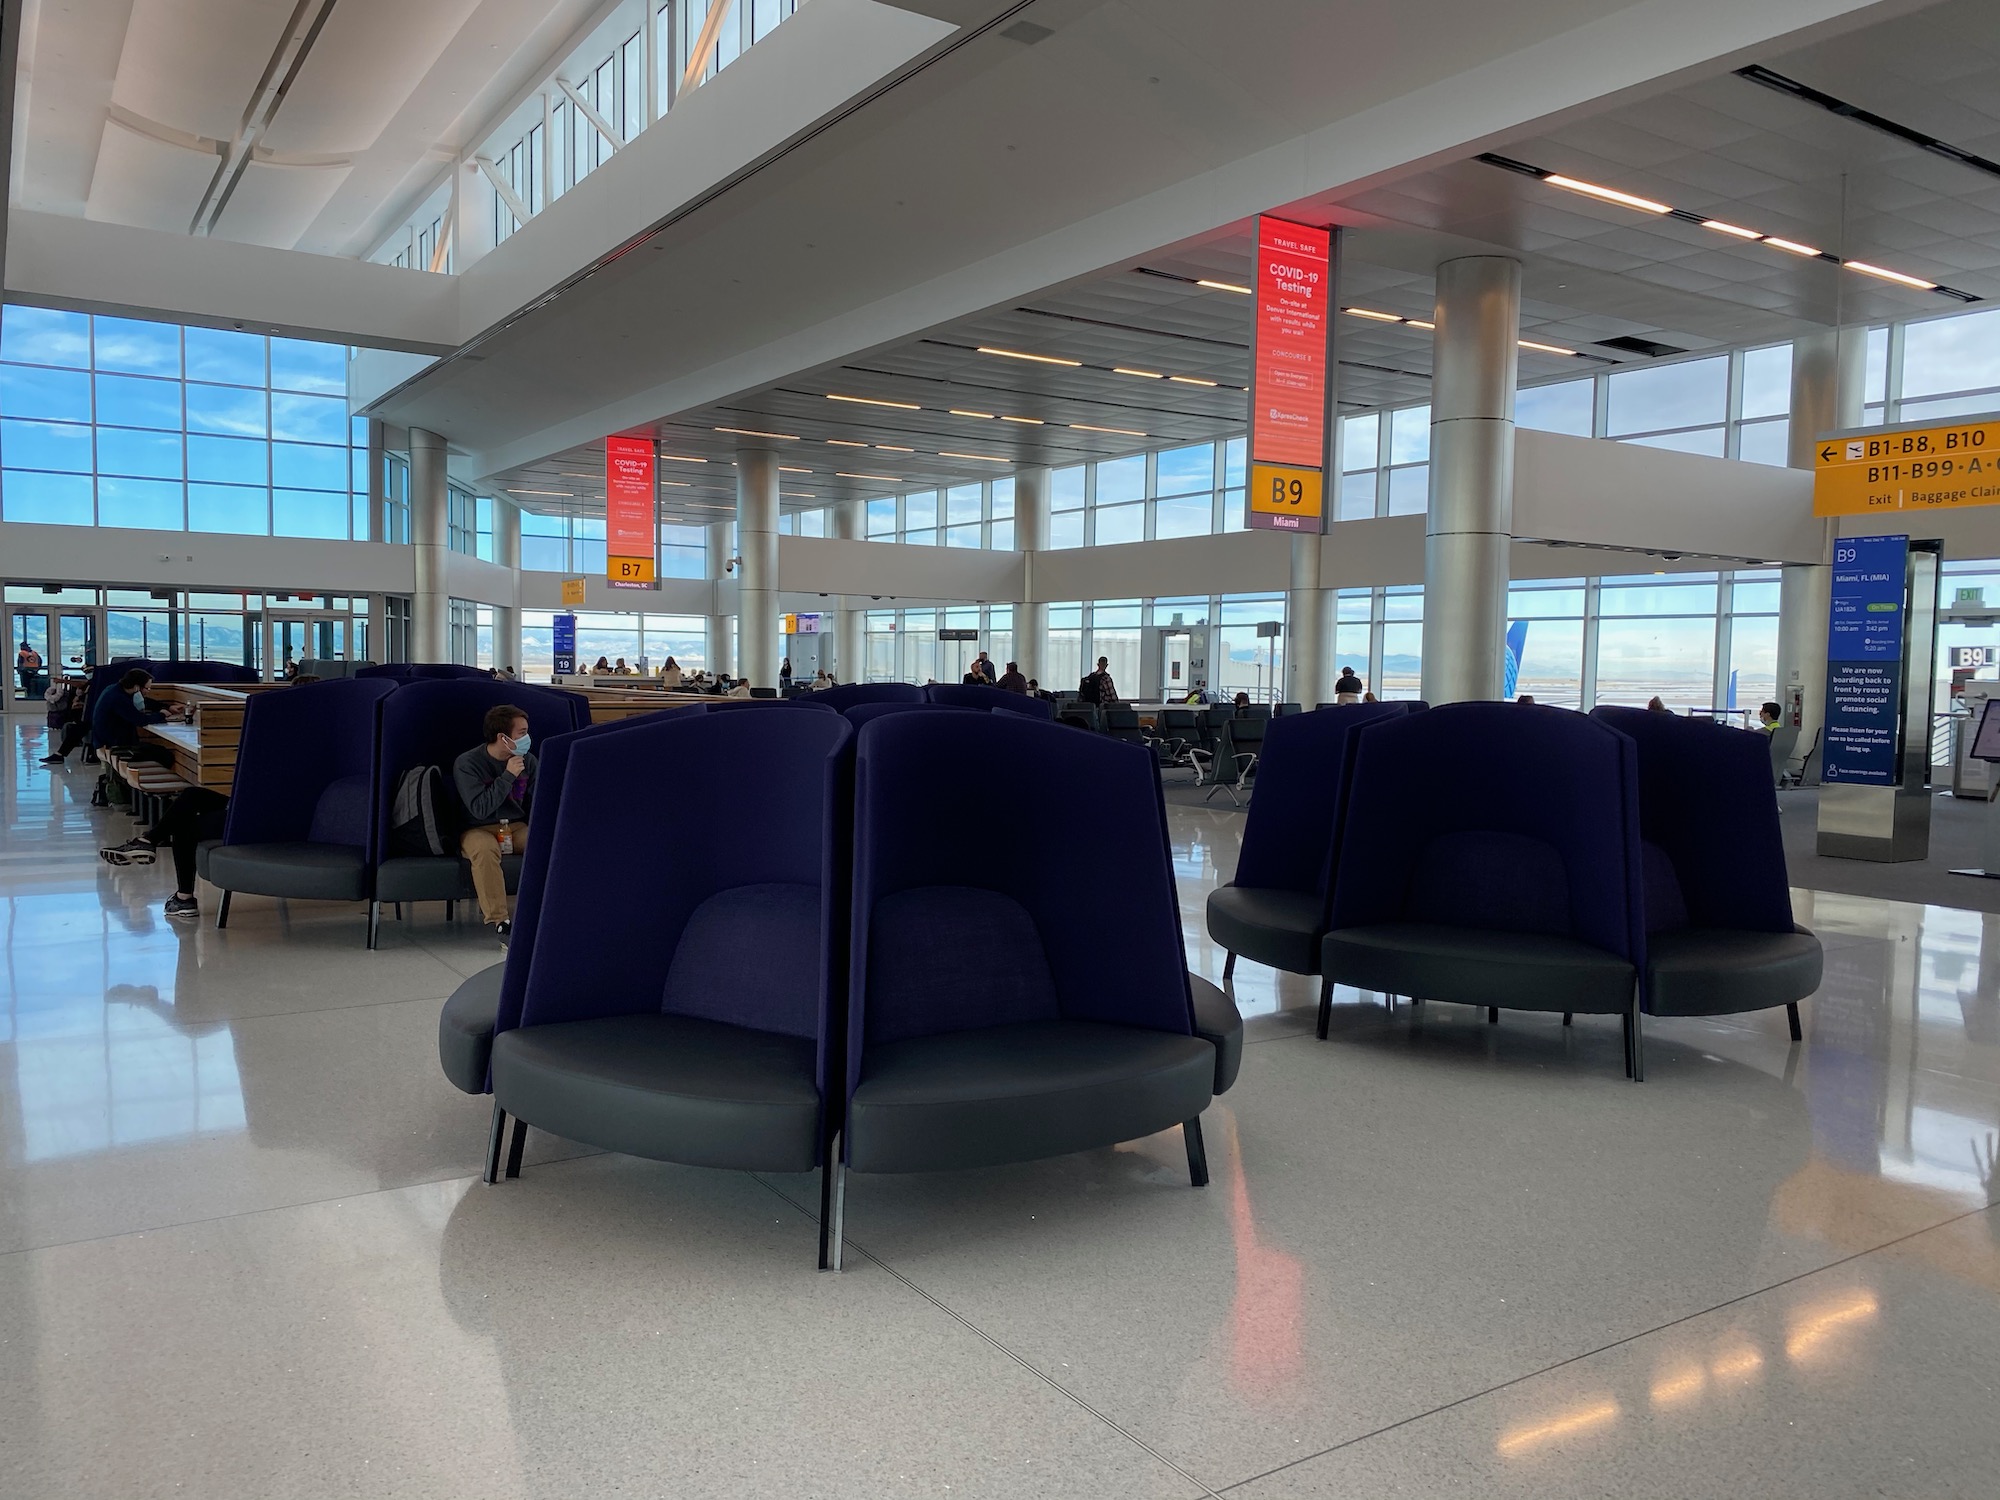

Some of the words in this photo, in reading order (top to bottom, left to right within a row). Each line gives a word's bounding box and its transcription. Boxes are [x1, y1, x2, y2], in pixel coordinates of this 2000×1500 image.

[1274, 238, 1298, 250] TRAVEL
[1300, 244, 1316, 253] SAFE
[1270, 263, 1318, 283] COVID-19
[1276, 278, 1312, 298] Testing
[1266, 304, 1285, 314] Denver
[1286, 308, 1320, 321] International
[1272, 350, 1306, 360] CONCOURSE
[1869, 436, 1935, 457] B1-B8,
[1946, 430, 1985, 449] B10
[614, 459, 648, 468] COVID-19
[619, 465, 644, 476] Testing
[1868, 460, 1954, 483] B11-B99
[1967, 457, 1982, 474] A
[1272, 477, 1303, 505] B9
[1869, 494, 1892, 505] Exit
[1911, 489, 1967, 504] Baggage
[1273, 516, 1299, 528] Miami
[1837, 548, 1856, 563] B9
[622, 563, 641, 577] B7
[1835, 575, 1860, 583] Miami,
[1861, 574, 1869, 582] FL
[1870, 573, 1890, 582] (MIA)
[1961, 589, 1979, 600] EXIT
[559, 660, 570, 669] 19
[1832, 676, 1864, 685] boarding
[1833, 685, 1852, 693] front
[1852, 686, 1862, 694] by
[1835, 695, 1865, 704] promote
[1866, 696, 1888, 704] social
[1841, 705, 1880, 715] distancing.
[1845, 745, 1862, 753] lining
